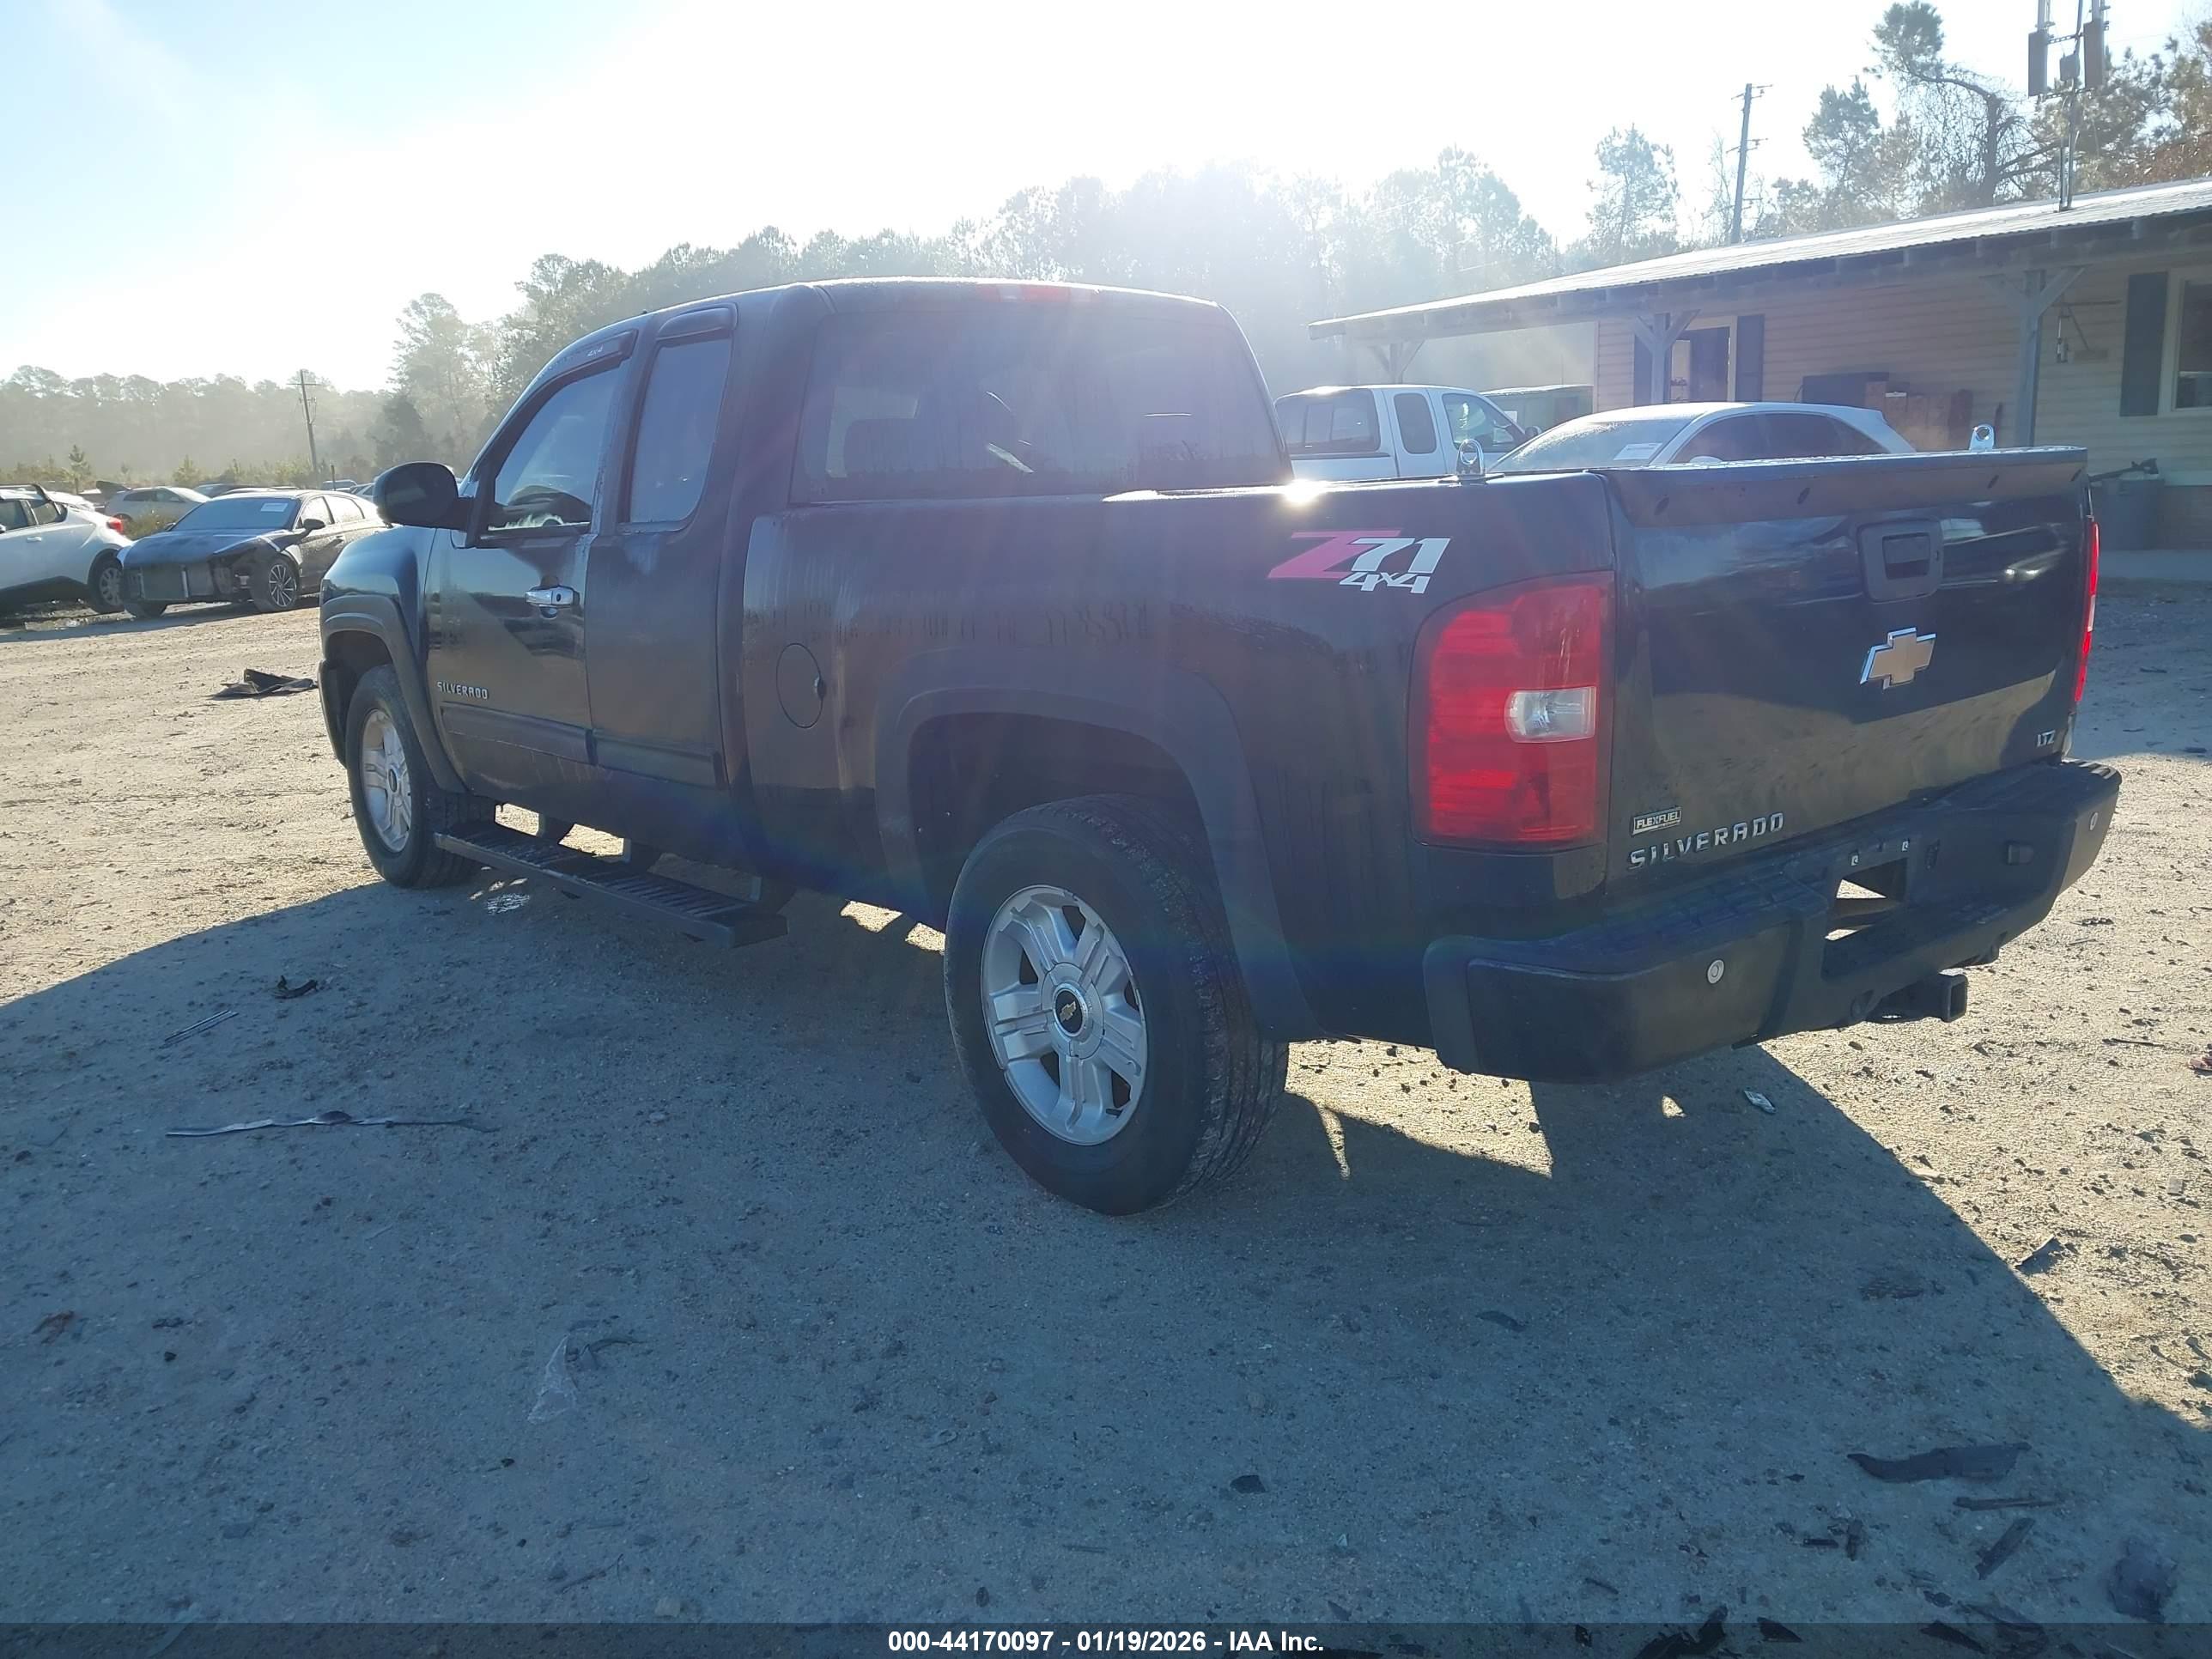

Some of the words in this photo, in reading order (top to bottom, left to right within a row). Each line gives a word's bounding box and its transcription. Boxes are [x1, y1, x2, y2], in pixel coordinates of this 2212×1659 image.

[1268, 529, 1450, 580] Z71
[436, 681, 489, 700] SILVERADO
[2037, 729, 2056, 747] LTZ
[1629, 811, 1784, 870] SILVERADO
